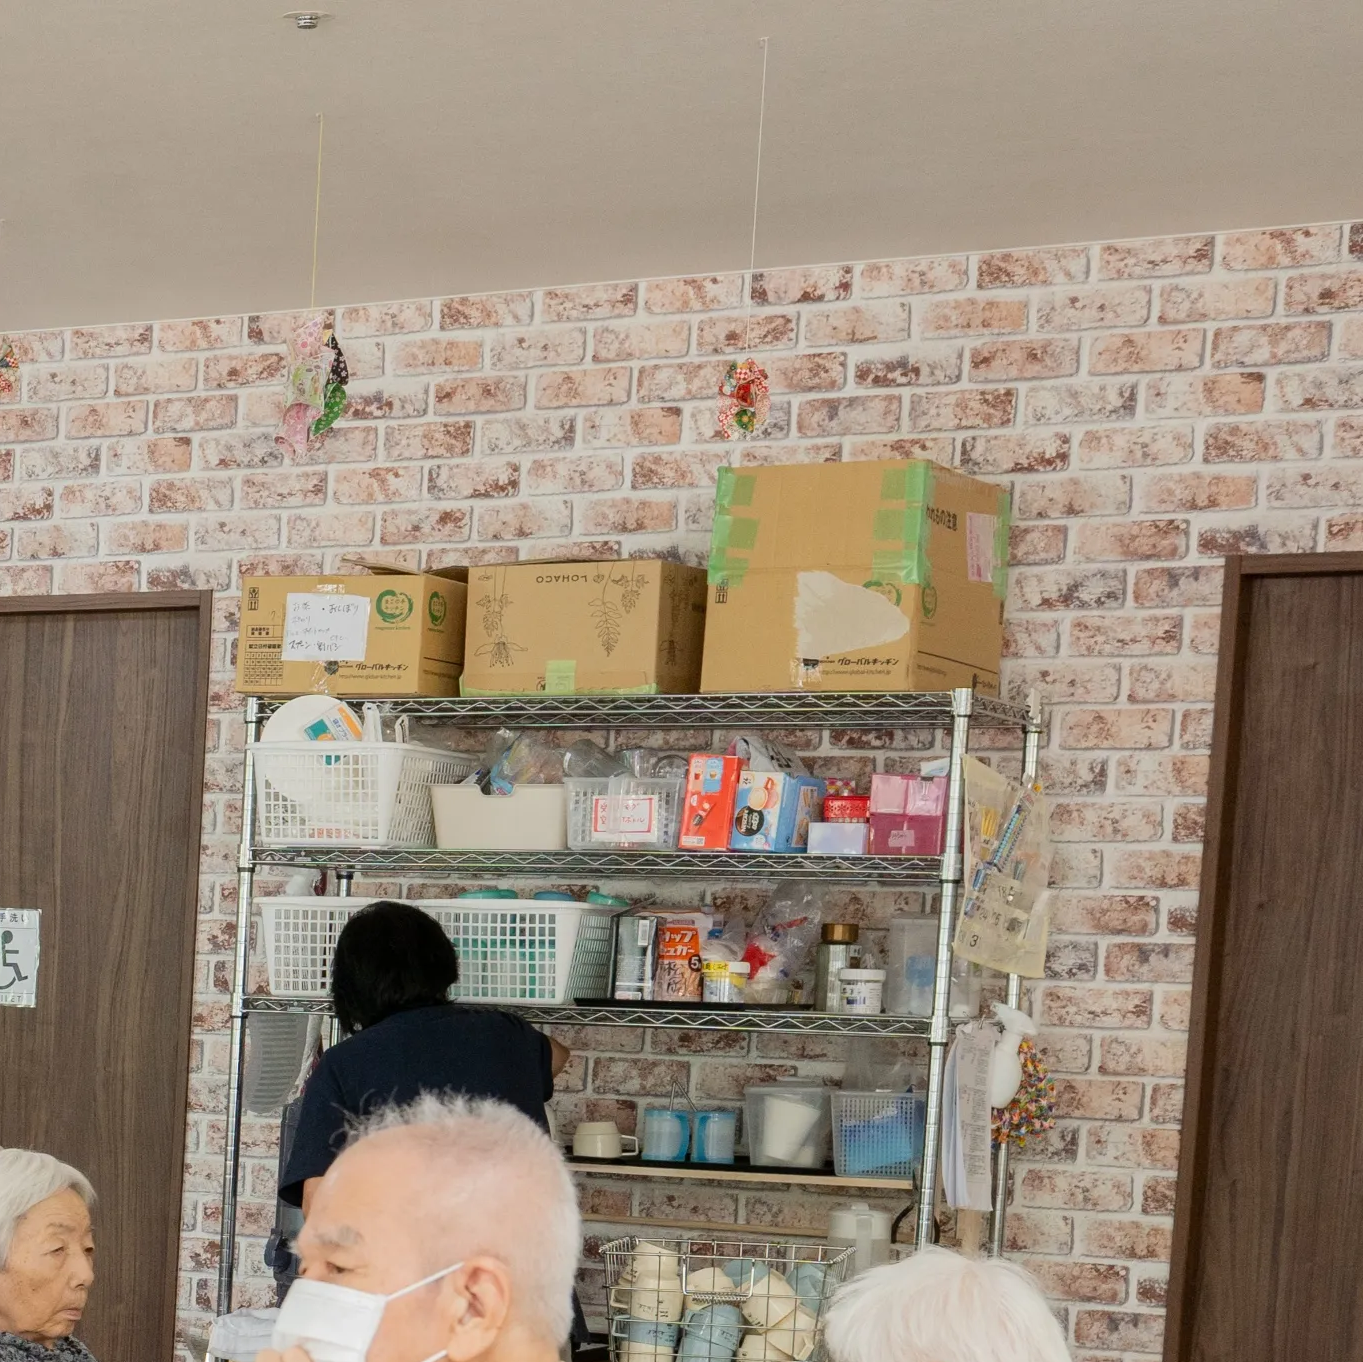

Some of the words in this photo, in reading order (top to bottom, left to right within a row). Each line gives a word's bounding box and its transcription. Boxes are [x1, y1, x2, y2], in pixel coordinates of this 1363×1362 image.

[536, 574, 588, 584] LOHACO
[838, 657, 899, 665] グローバルキッチン
[970, 935, 979, 947] 3
